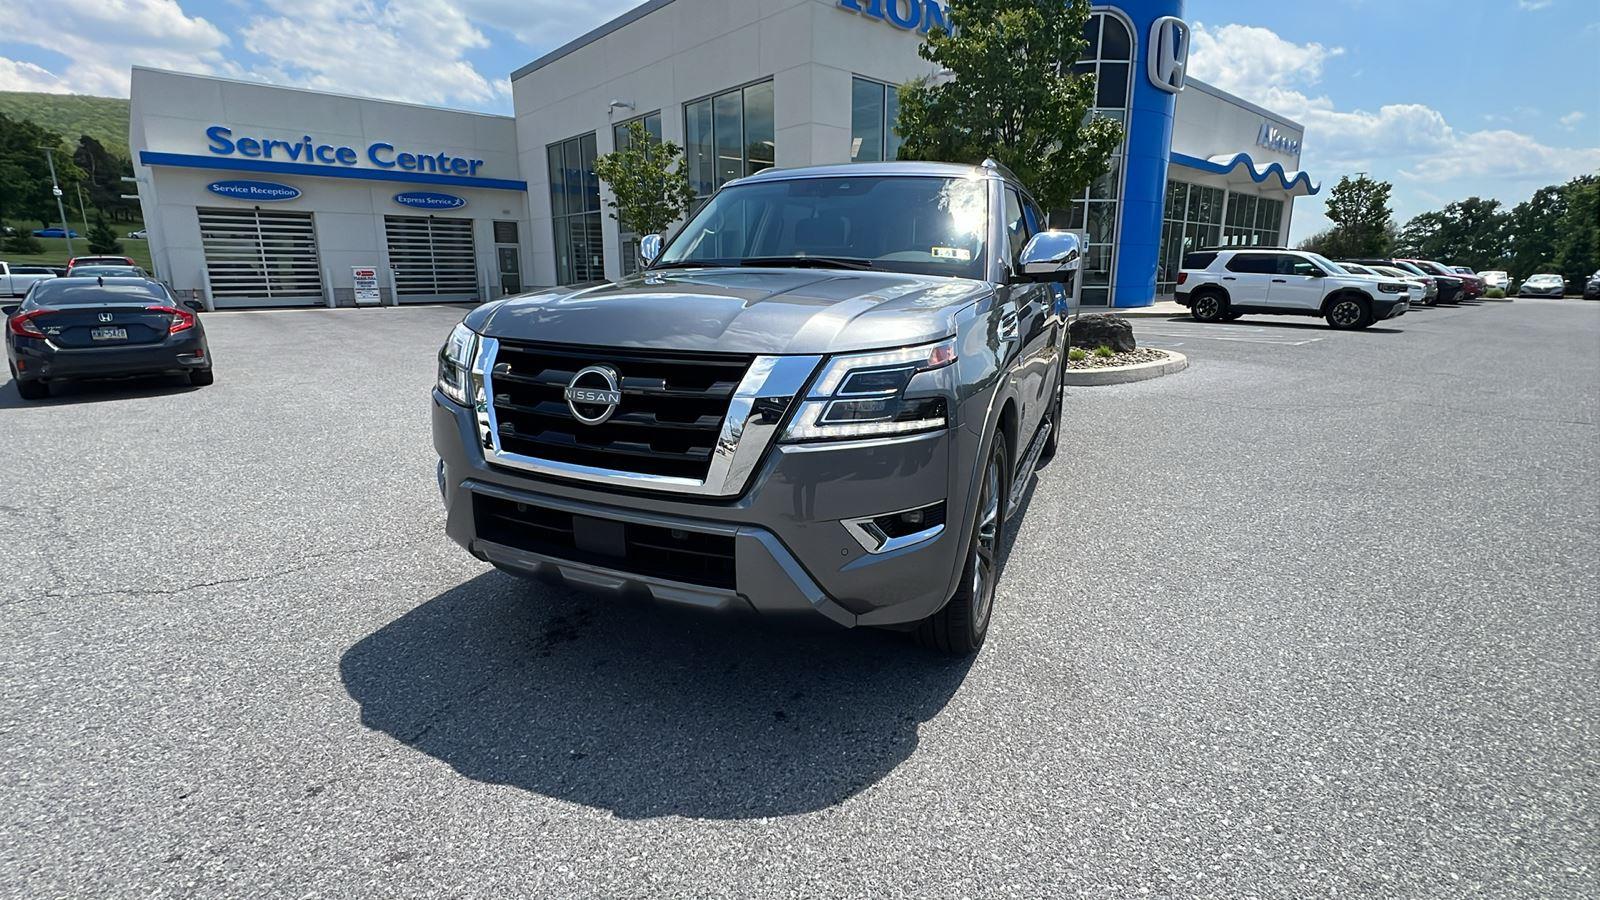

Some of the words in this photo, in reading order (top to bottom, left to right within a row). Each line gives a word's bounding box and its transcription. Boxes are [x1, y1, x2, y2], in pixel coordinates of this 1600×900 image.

[206, 126, 357, 165] Service
[368, 142, 484, 176] Center
[212, 183, 249, 193] Service
[250, 186, 296, 196] Reception
[398, 195, 425, 204] Express
[426, 197, 452, 205] Service
[565, 389, 619, 403] NISSAN
